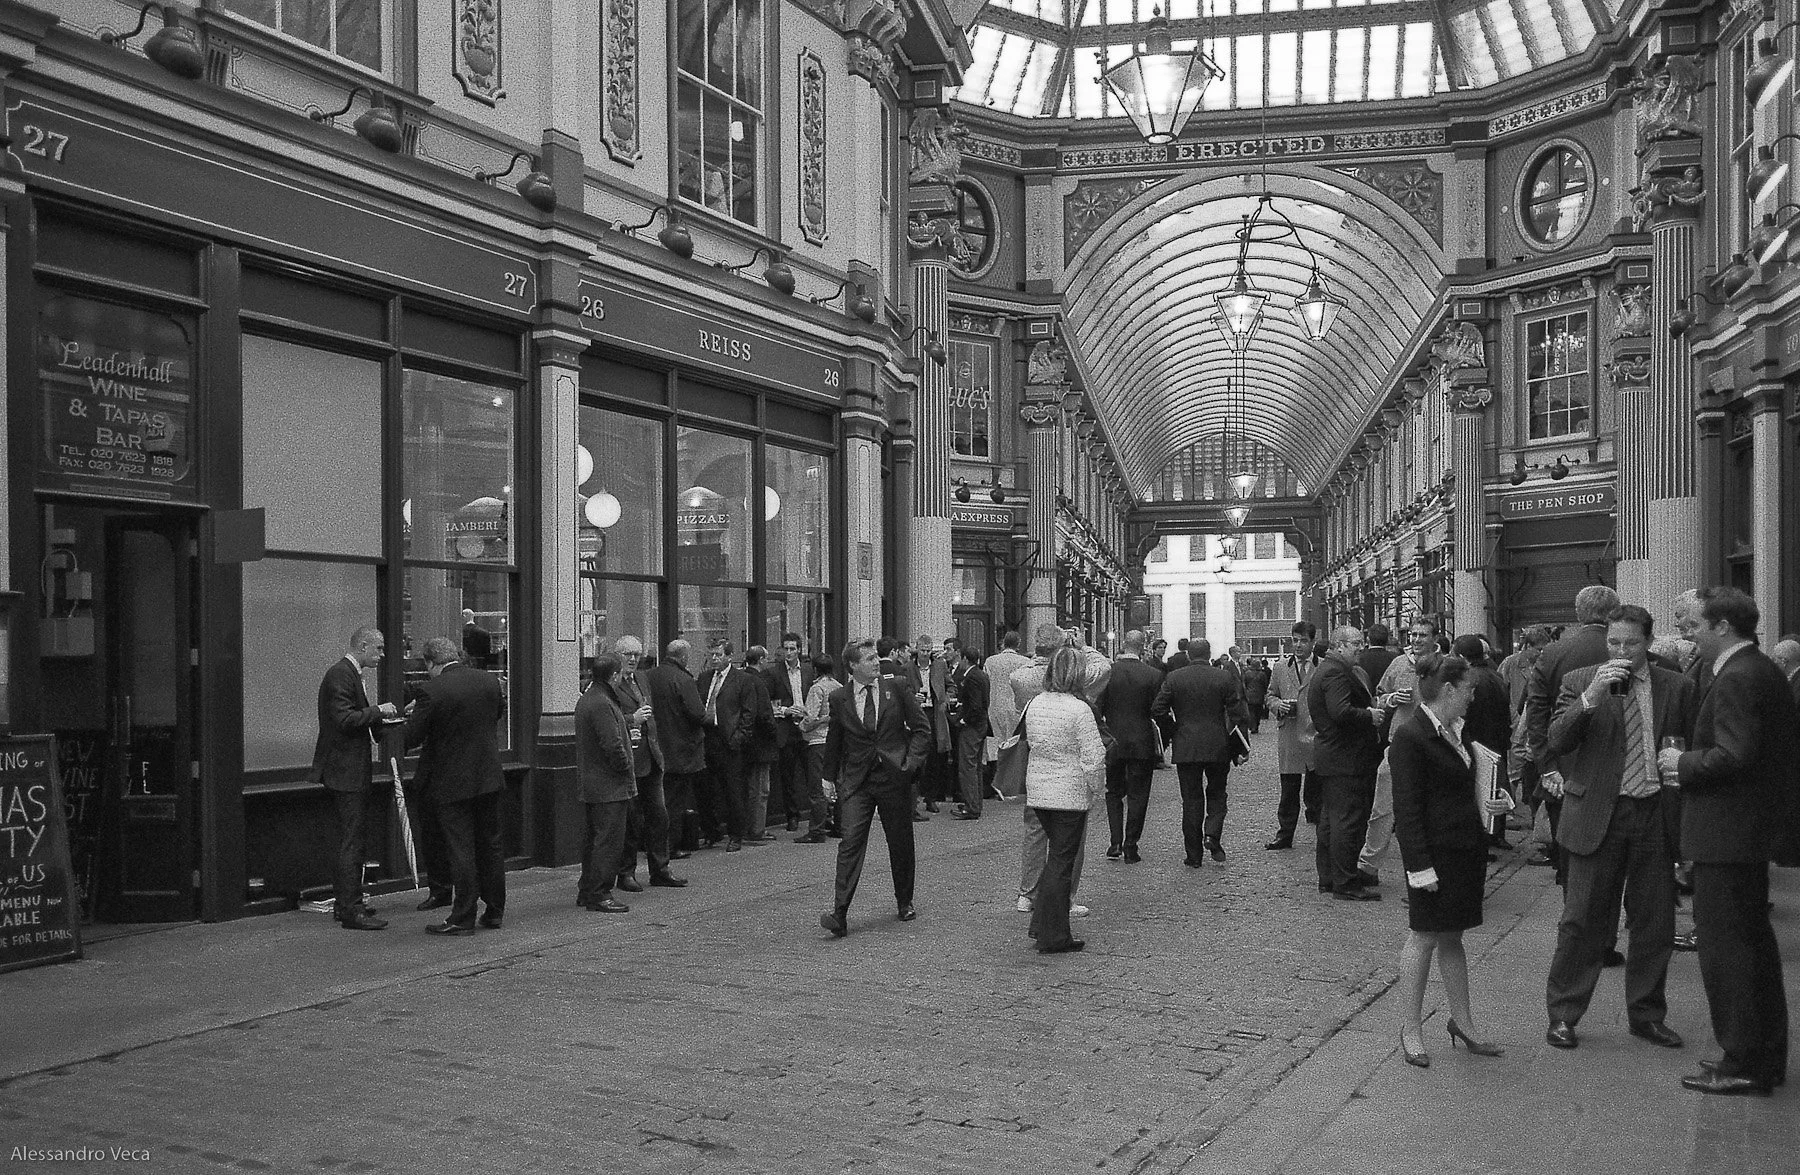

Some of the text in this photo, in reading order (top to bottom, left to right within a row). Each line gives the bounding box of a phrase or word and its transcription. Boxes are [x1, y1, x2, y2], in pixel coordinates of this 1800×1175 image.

[23, 124, 69, 161] 27
[1175, 136, 1326, 161] ERECTED
[504, 272, 527, 297] 27
[581, 295, 604, 320] 26
[699, 329, 751, 361] REISS
[58, 341, 173, 383] Leadenhall
[824, 368, 839, 387] 26
[88, 375, 147, 402] WINE
[69, 398, 166, 429] & TAPAS
[96, 426, 142, 449] BAR
[88, 459, 112, 471] 020
[90, 448, 114, 459] 020
[153, 455, 174, 466] 1818
[1509, 493, 1604, 511] THE PEN SHOP
[951, 512, 1009, 524] AEXPRESS
[22, 863, 46, 882] US
[0, 895, 41, 910] MENU
[0, 910, 41, 928] ABLE
[12, 933, 32, 946] FOR
[35, 929, 73, 942] DETAILS
